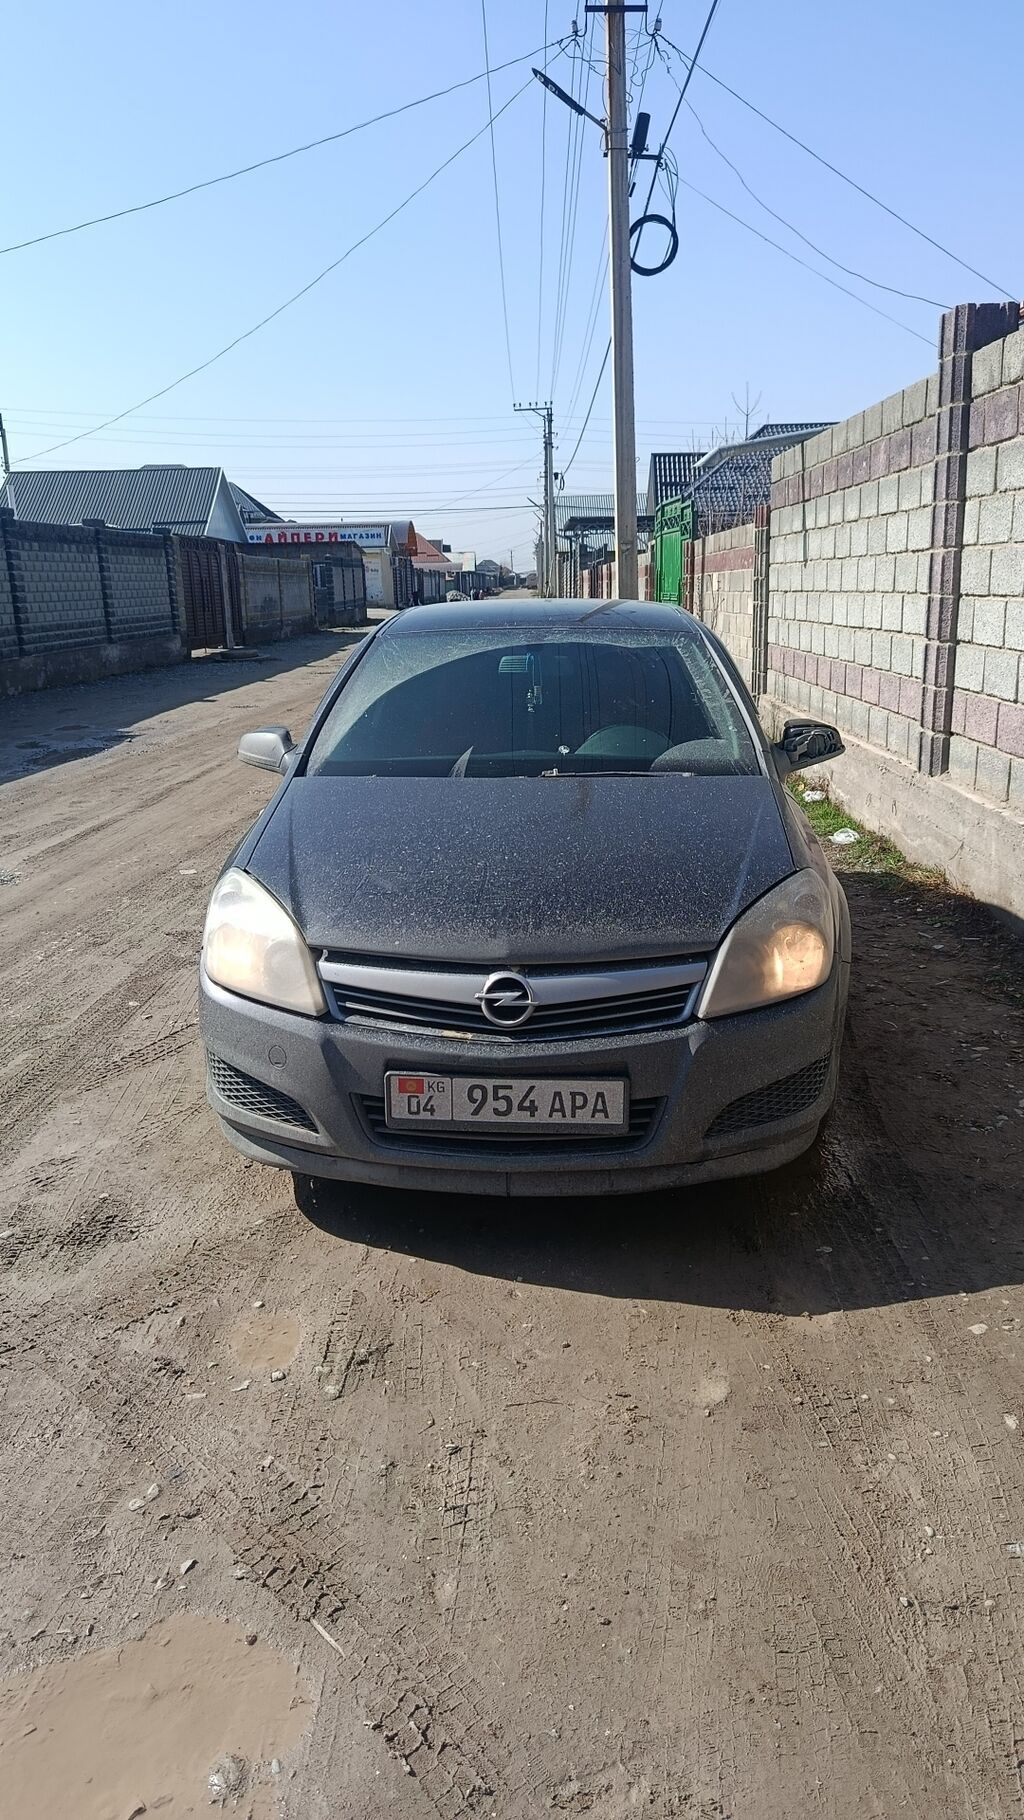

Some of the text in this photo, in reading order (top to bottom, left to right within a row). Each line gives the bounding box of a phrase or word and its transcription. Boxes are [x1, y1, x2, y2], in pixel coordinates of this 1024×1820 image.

[265, 531, 339, 544] АЙПЕРИ
[340, 532, 382, 540] МАГАЗИН
[427, 1080, 445, 1093] KG
[407, 1095, 436, 1116] 04
[467, 1084, 610, 1119] 954 APA
